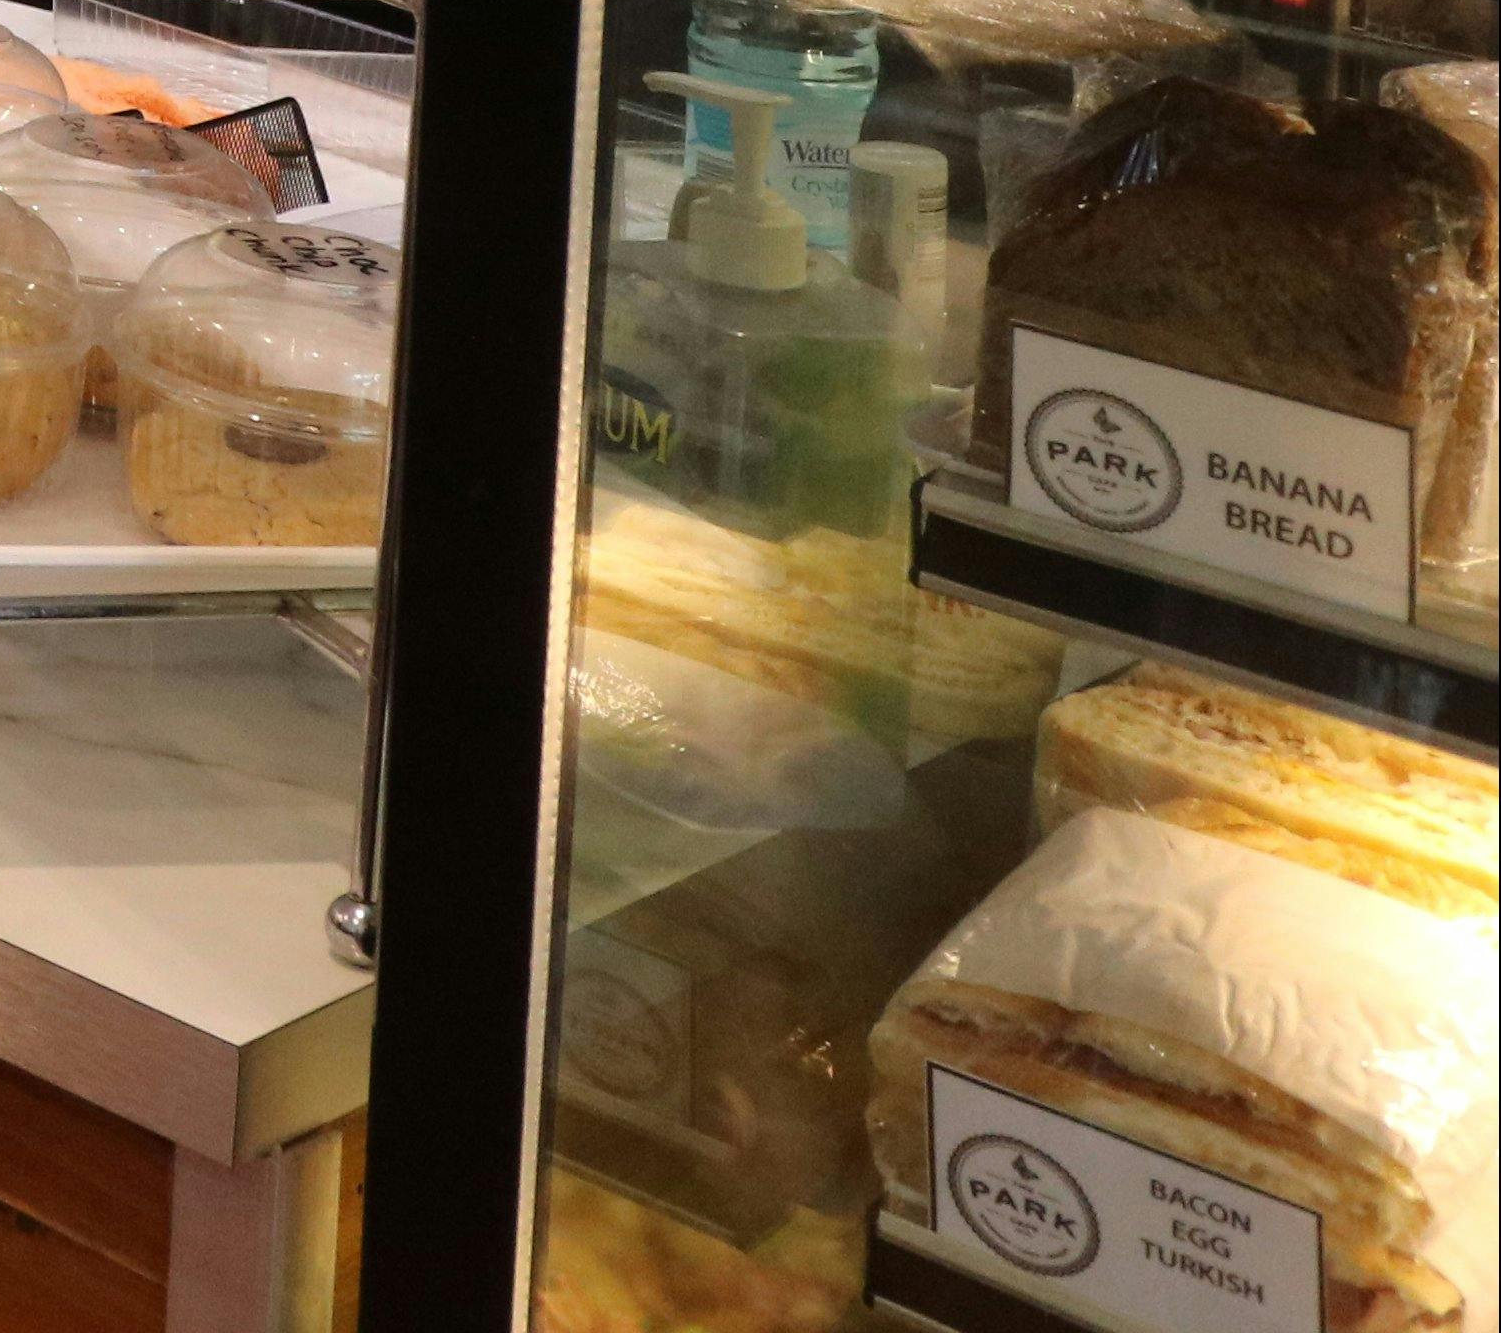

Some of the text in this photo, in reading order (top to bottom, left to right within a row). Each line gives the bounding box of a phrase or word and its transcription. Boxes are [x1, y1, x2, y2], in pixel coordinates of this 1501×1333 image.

[1047, 439, 1158, 490] PARK
[1206, 450, 1374, 524] BANANA
[1224, 499, 1355, 561] BREAD
[968, 1177, 1077, 1241] PARK
[1148, 1177, 1253, 1235] BACON
[1138, 1236, 1267, 1306] TURKISH
[1170, 1218, 1233, 1262] EGG
